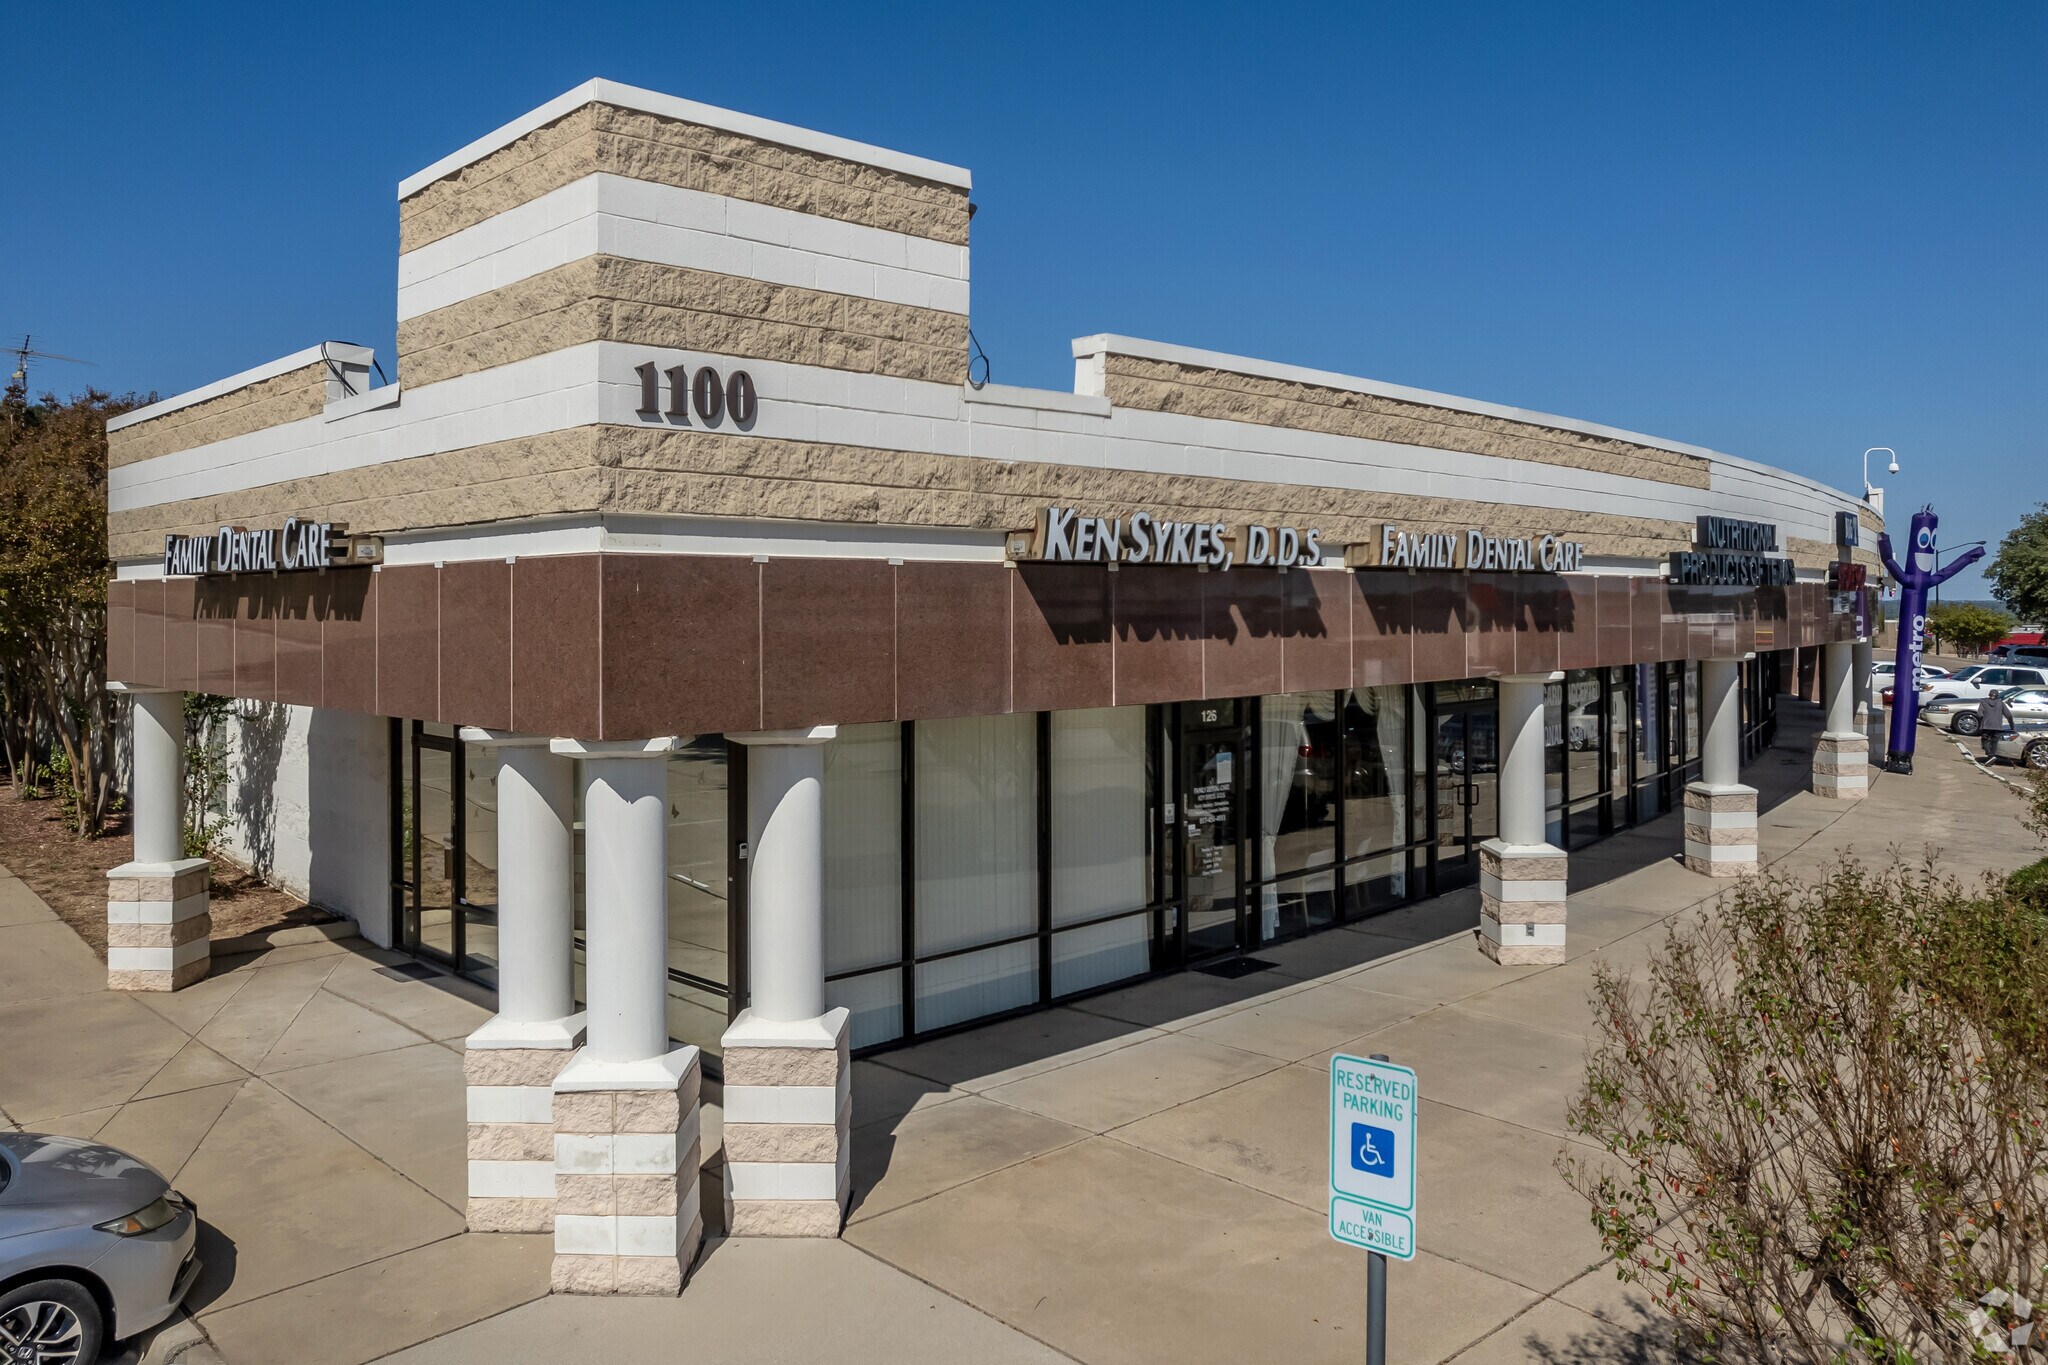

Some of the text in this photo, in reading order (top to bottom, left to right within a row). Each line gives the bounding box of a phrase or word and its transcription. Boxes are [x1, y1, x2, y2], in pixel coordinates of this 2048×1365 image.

[634, 361, 756, 423] 1100
[164, 516, 330, 575] FAMILY DENTAL CARE
[1044, 506, 1327, 572] KEN SYKES, D.D.S.
[1381, 523, 1584, 572] FAMILY DENTAL CARE
[1708, 516, 1778, 552] NUTRITIONAL
[1681, 552, 1797, 587] PRODUCTS OF TEXAS
[1909, 614, 1925, 692] metro
[1201, 709, 1217, 723] 126
[1337, 1069, 1410, 1101] RESERVED
[1343, 1092, 1403, 1122] PARKING
[1339, 1220, 1405, 1251] ACCESSIBLE
[1361, 1209, 1382, 1228] VAN
